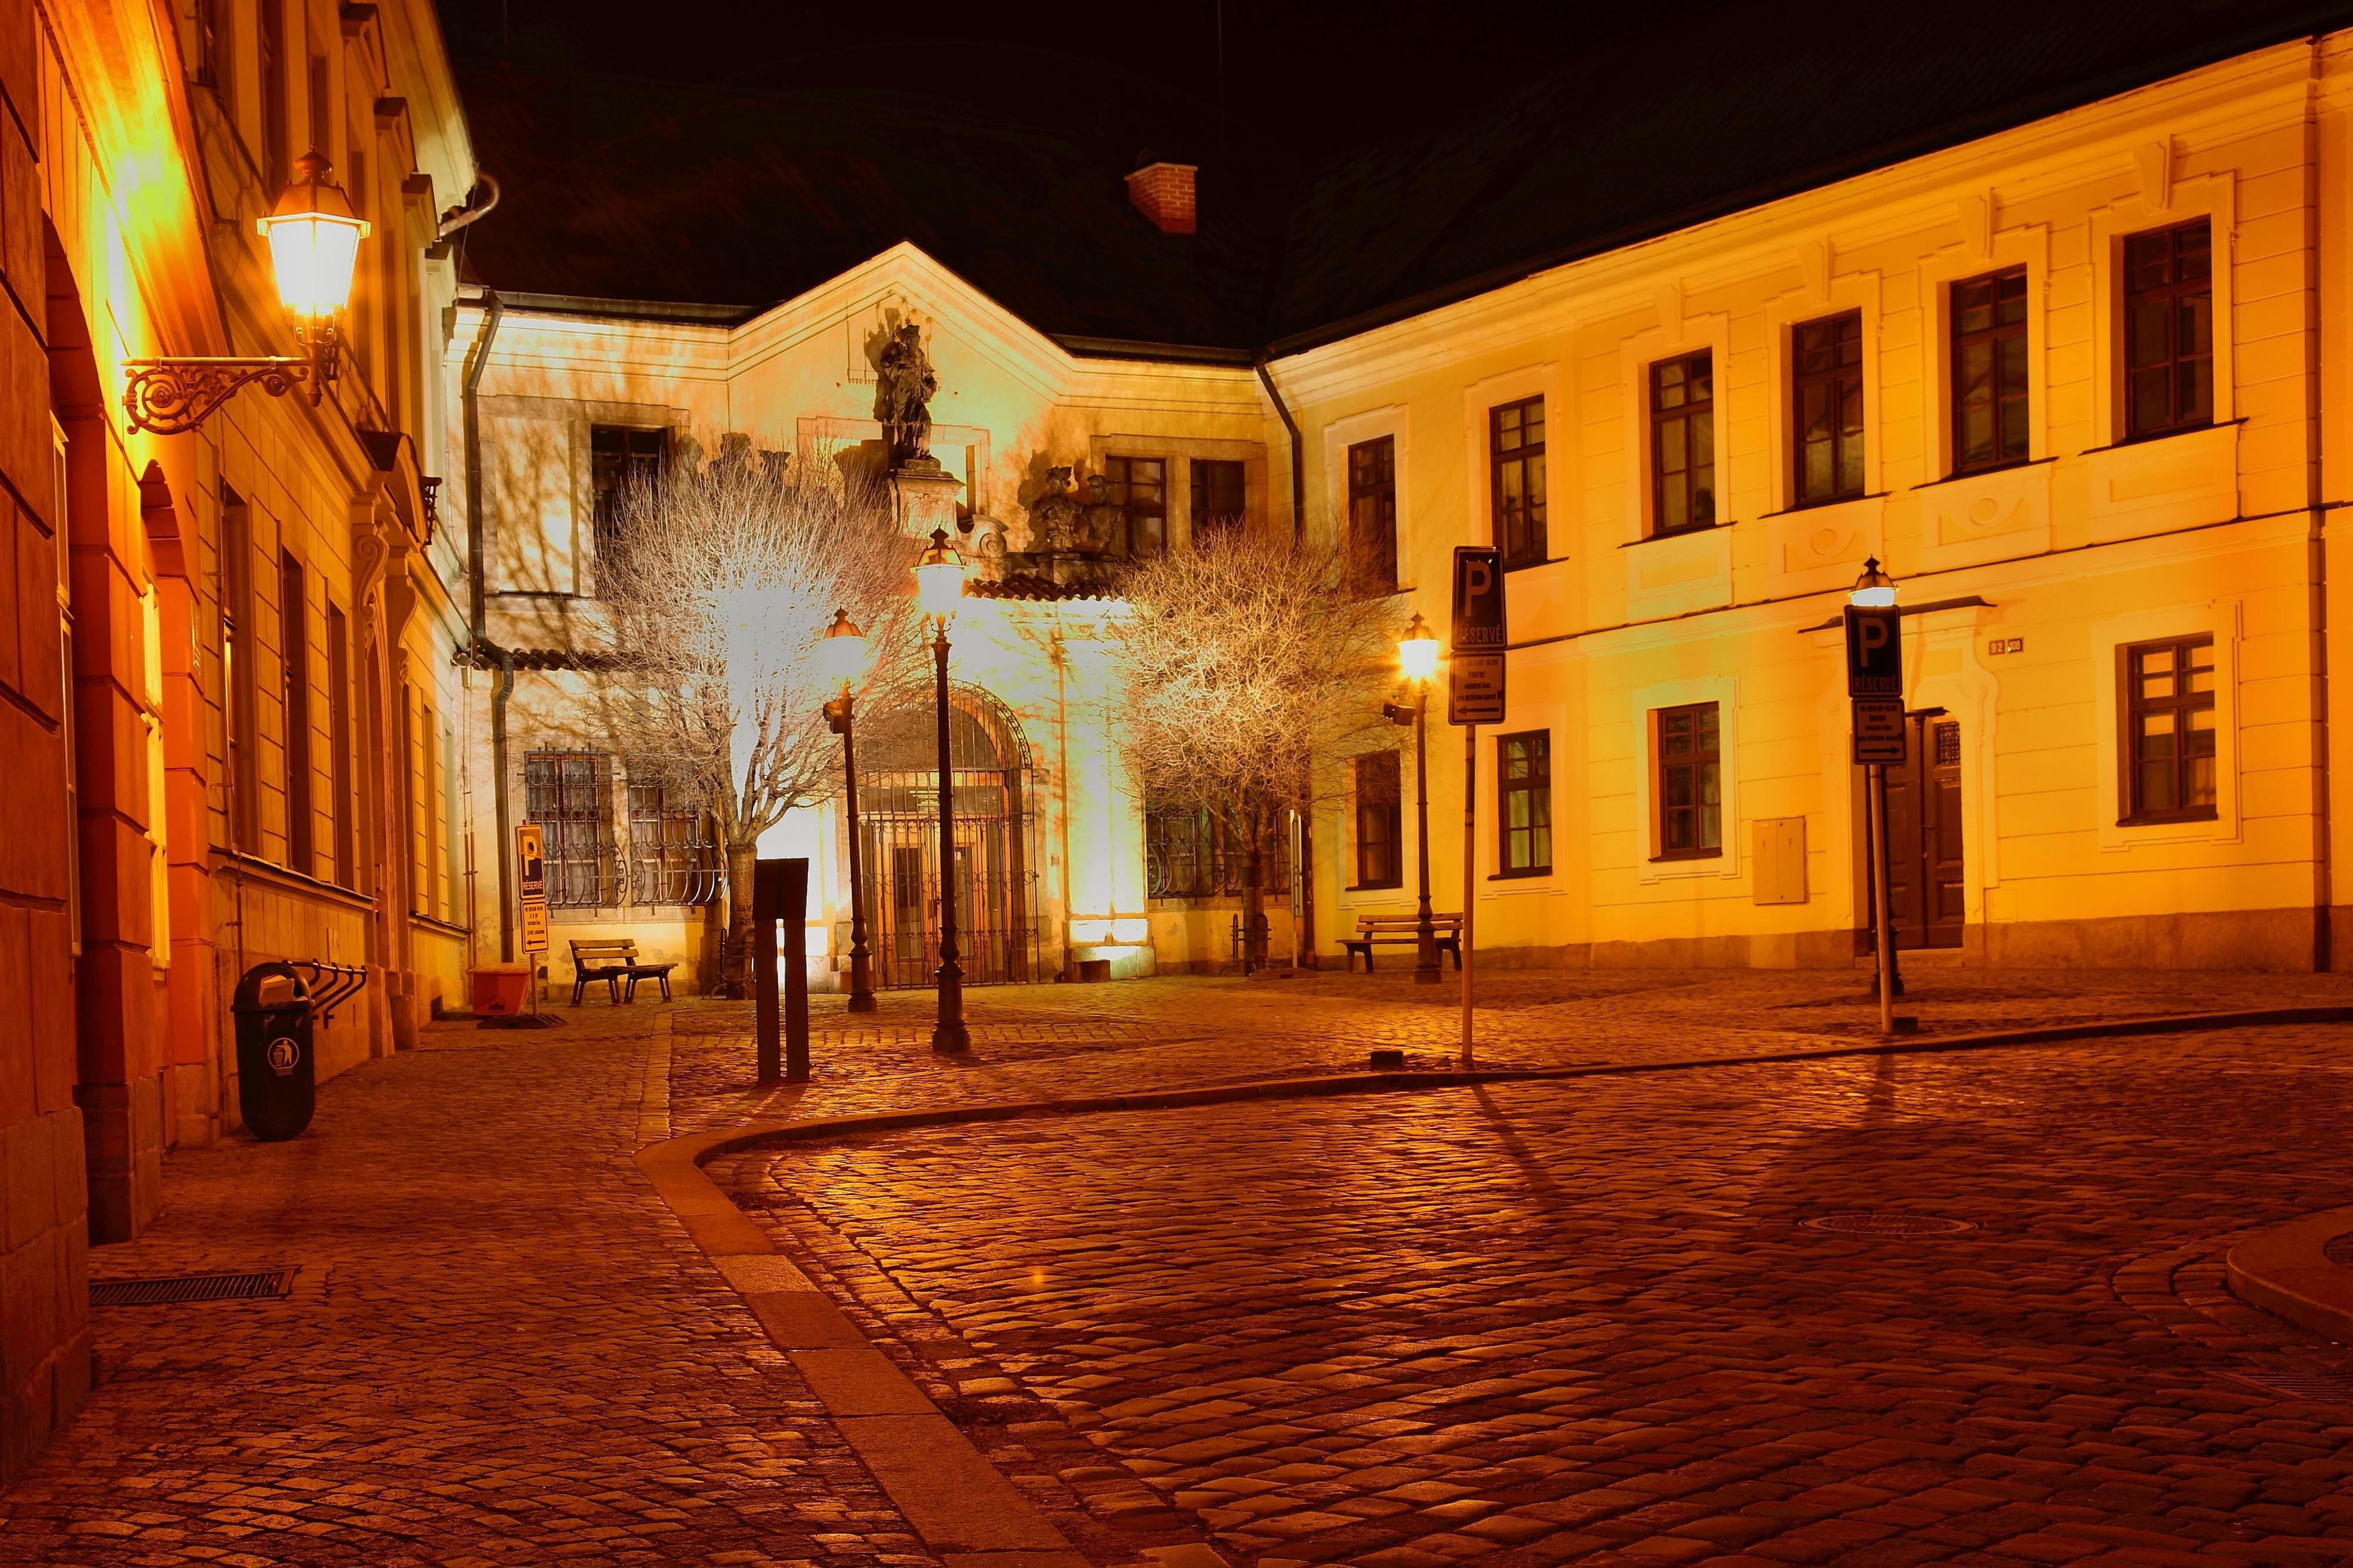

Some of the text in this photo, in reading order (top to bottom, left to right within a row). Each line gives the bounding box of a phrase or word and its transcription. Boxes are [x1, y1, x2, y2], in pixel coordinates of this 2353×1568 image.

[1465, 561, 1492, 616] P
[1458, 623, 1502, 643] RÉSERVÉ
[1859, 618, 1888, 667] P
[1854, 673, 1897, 691] RÉSERVÉ
[524, 836, 537, 876] P
[522, 879, 543, 890] RÉSERVÉ
